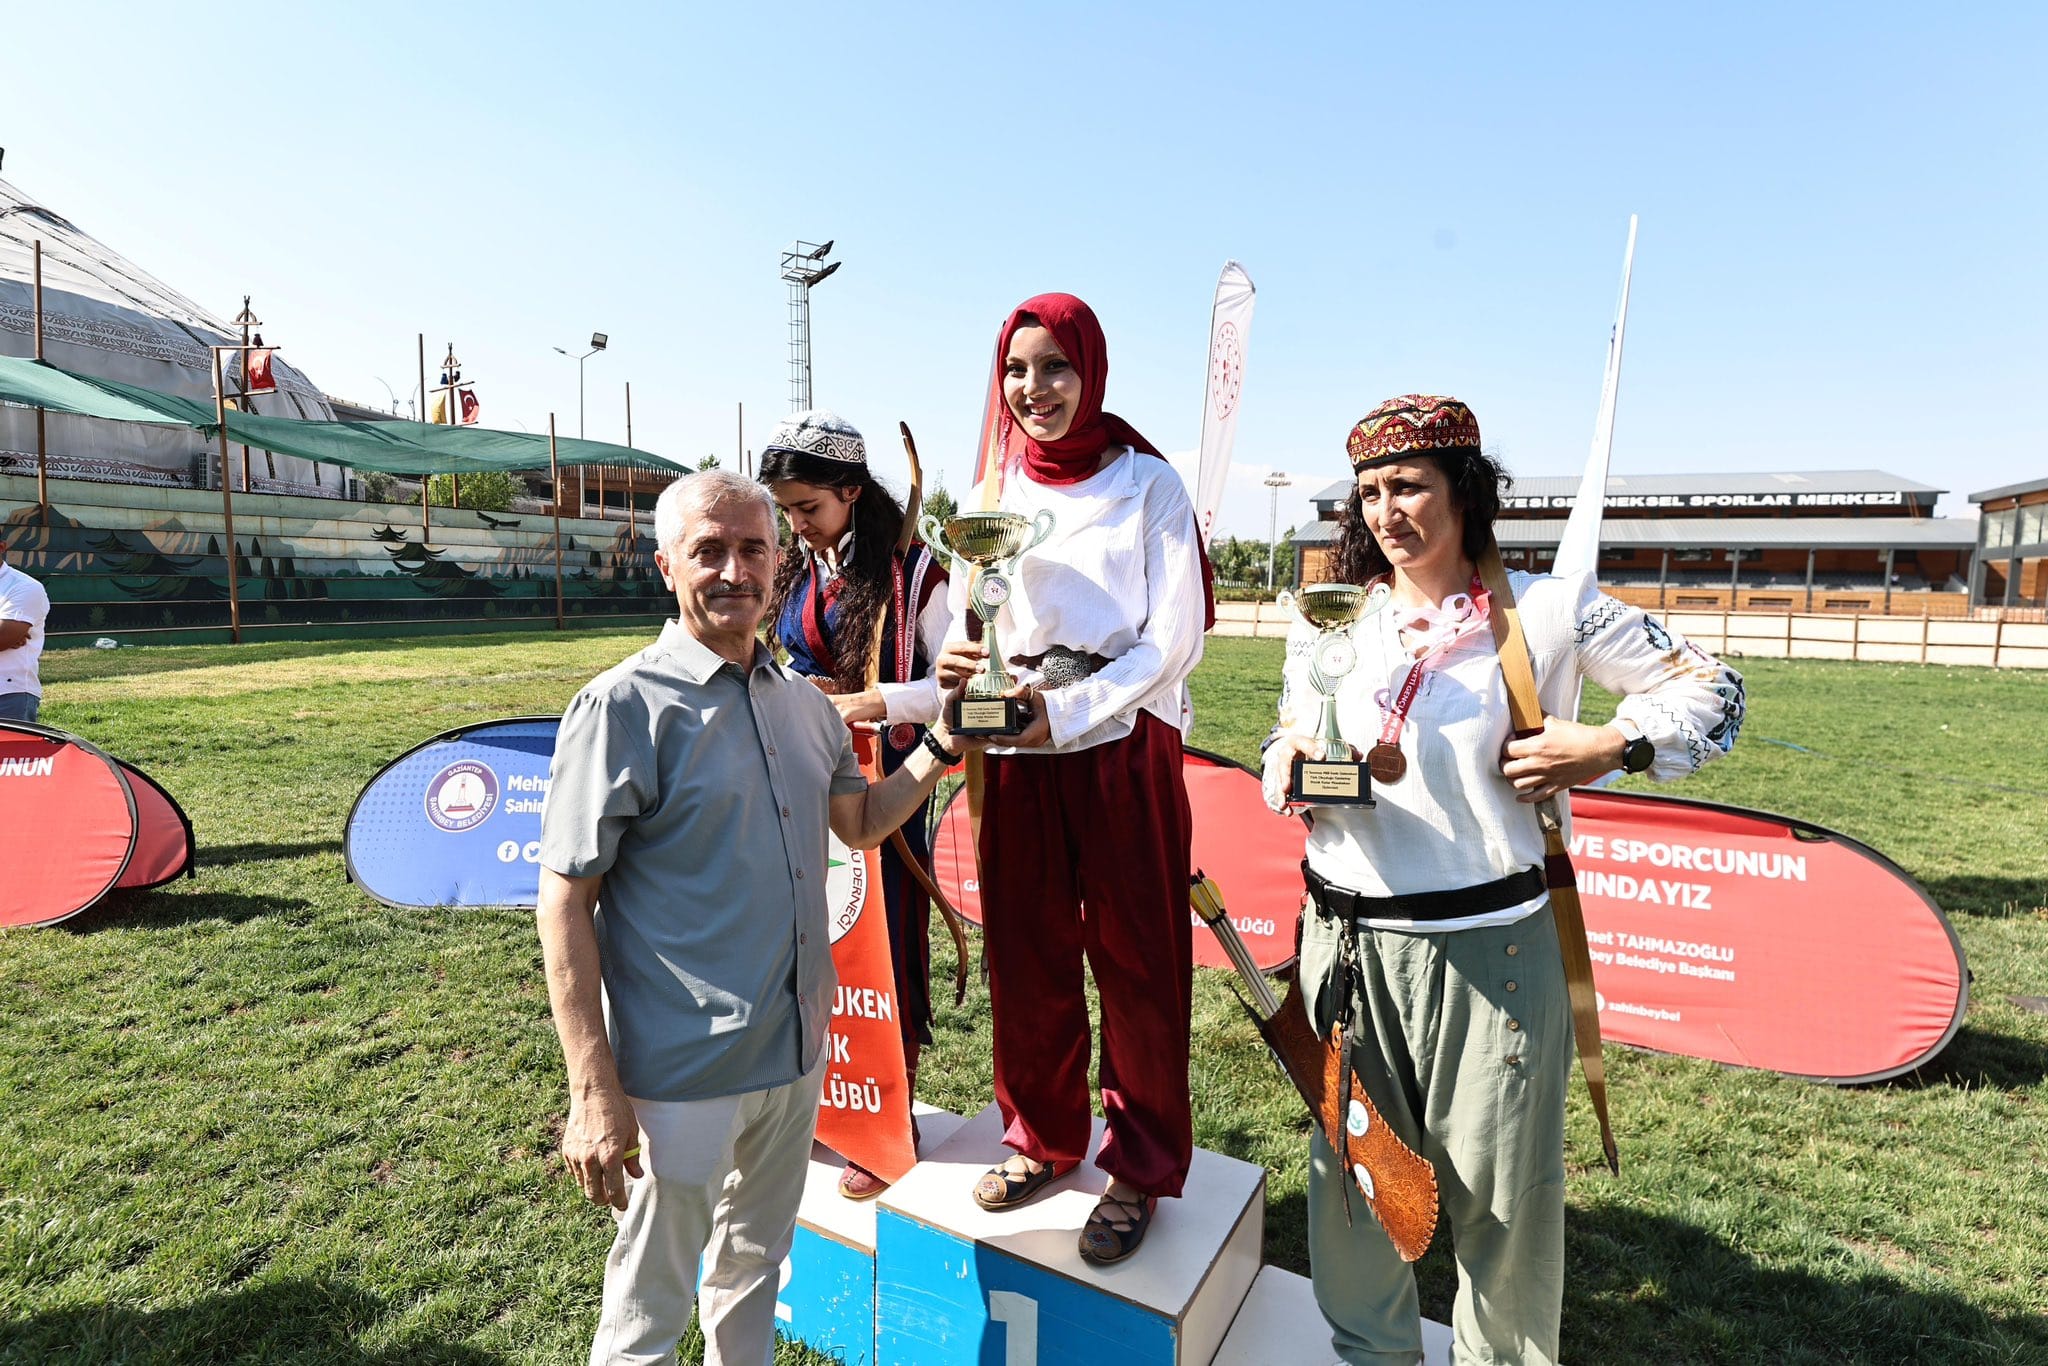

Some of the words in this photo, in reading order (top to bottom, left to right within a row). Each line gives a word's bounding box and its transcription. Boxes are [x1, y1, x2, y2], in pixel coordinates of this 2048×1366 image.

[1552, 496, 1685, 508] GENEKSEL
[1689, 494, 1792, 507] SPORLAR
[1797, 491, 1902, 506] MERKEZİ
[1610, 839, 1806, 881] SPORCUNUN
[1615, 952, 1676, 974] Belediye
